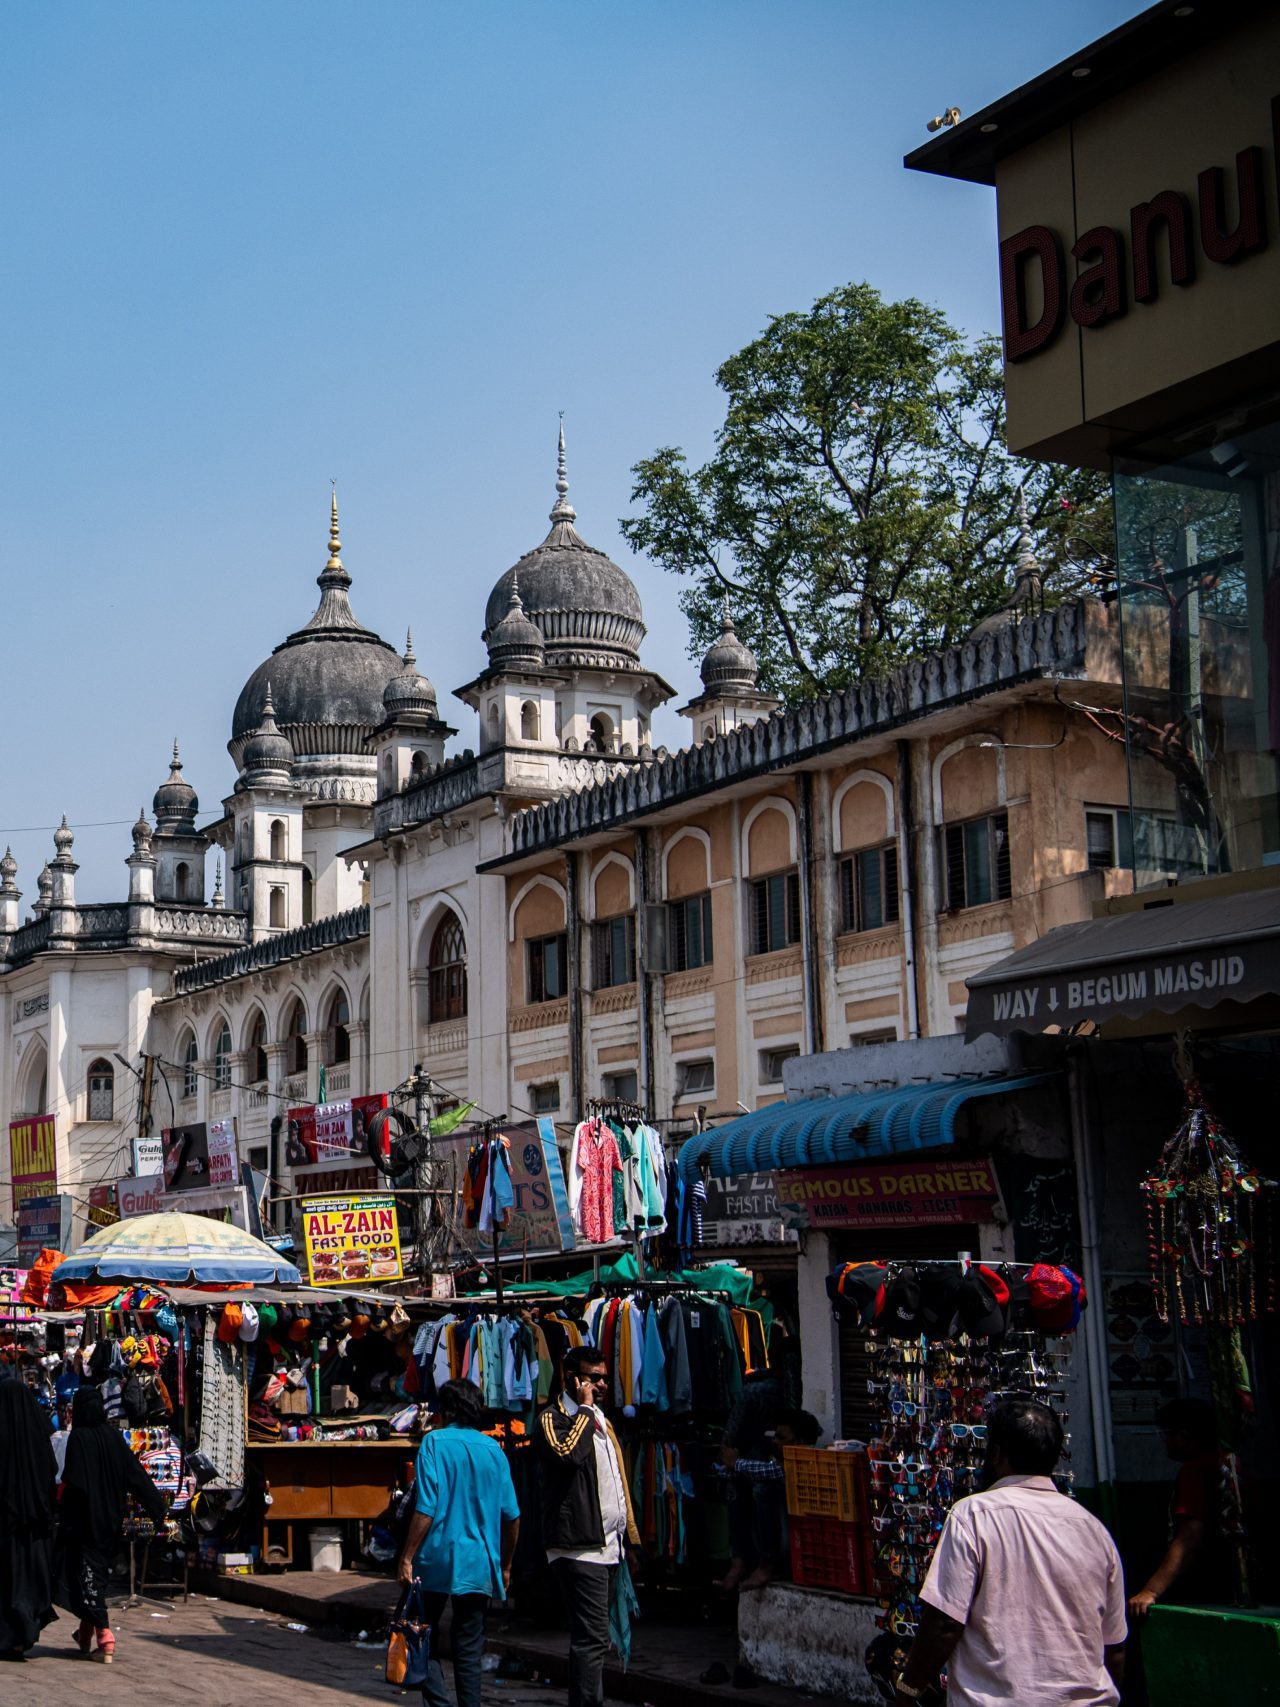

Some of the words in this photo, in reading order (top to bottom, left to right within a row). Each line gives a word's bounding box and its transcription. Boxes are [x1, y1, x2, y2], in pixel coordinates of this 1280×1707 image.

[1000, 94, 1280, 364] Danu
[993, 987, 1039, 1021] WAY
[1068, 970, 1147, 1009] BEGUM
[1154, 956, 1245, 996] MASJID
[10, 1121, 55, 1177] MILAN
[777, 1177, 874, 1201] FAMOUS
[880, 1170, 992, 1195] DARNER
[726, 1195, 759, 1215] FAST
[813, 1203, 848, 1217] KATAN
[857, 1199, 912, 1215] BANARAS
[308, 1209, 394, 1236] AL-ZAIN
[311, 1235, 346, 1250] FAST
[352, 1232, 393, 1247] FOOD
